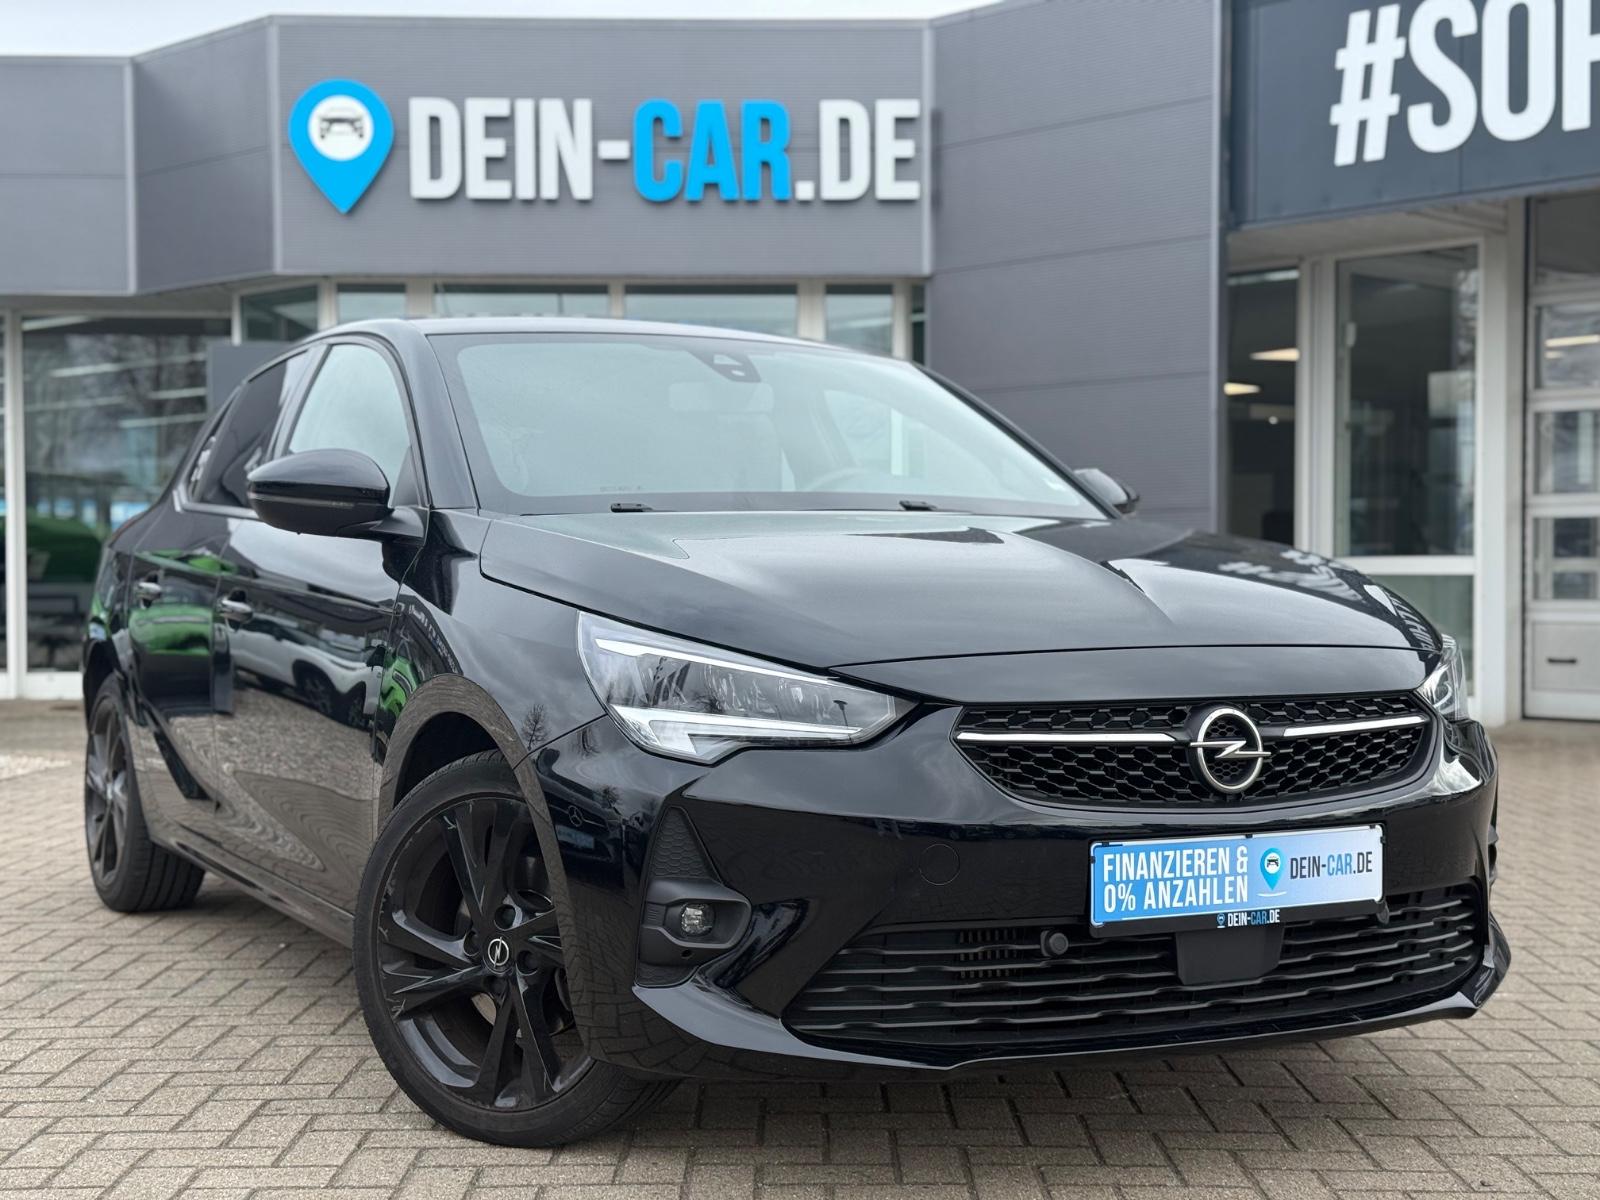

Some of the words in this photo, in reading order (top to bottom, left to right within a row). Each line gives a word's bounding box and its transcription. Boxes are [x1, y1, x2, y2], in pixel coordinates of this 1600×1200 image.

[409, 97, 921, 201] DEIN-CAR.DE
[1104, 847, 1230, 881] FINANZIEREN
[1236, 846, 1248, 872] &
[1290, 851, 1372, 879] DEIN-CAR.DE
[1104, 884, 1135, 911] 0%
[1144, 875, 1248, 908] ANZAHLEN
[1227, 910, 1280, 926] DEIN-CAR.DE
